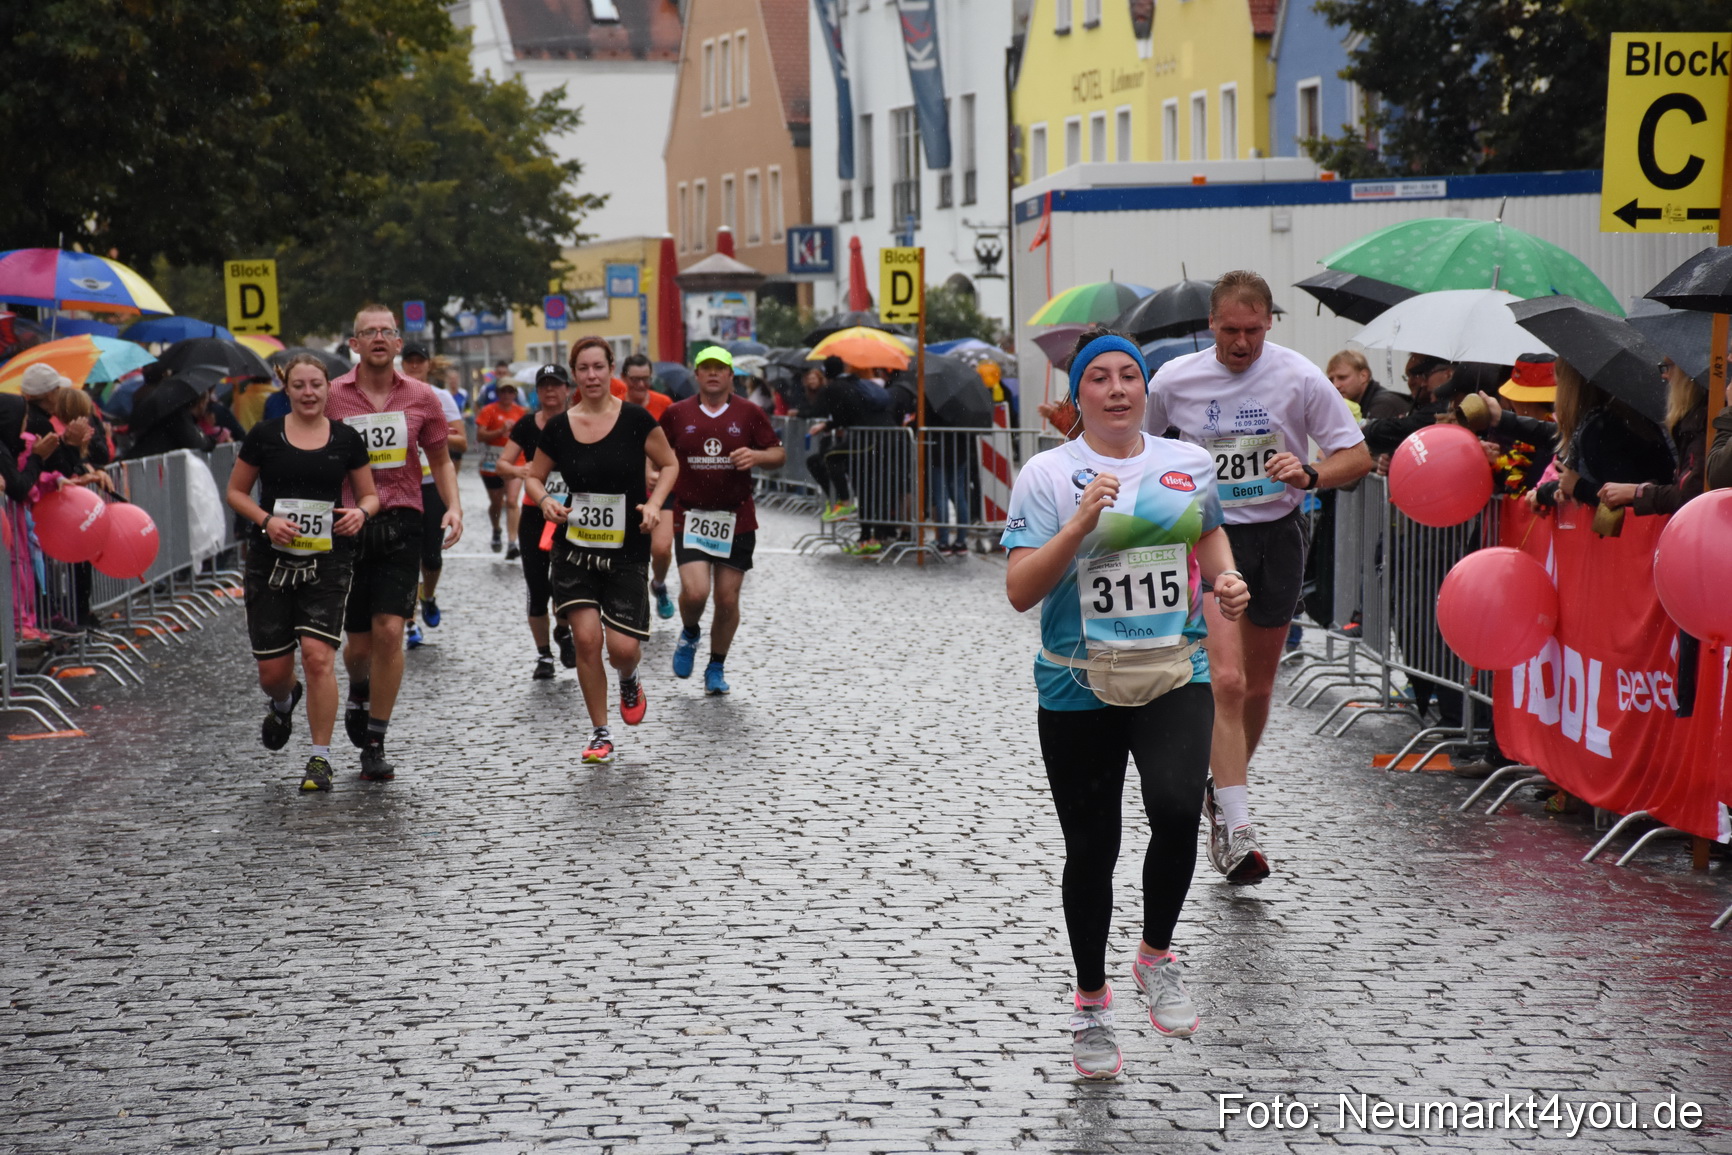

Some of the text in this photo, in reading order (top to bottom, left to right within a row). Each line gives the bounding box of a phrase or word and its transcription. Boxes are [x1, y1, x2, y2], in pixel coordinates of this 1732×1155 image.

[1626, 42, 1730, 76] Block
[1072, 69, 1102, 104] HOTEL
[1638, 92, 1708, 191] C
[884, 250, 919, 264] Block
[231, 264, 270, 277] Block
[892, 270, 912, 305] D
[240, 284, 265, 319] D
[1234, 419, 1270, 427] 16.09.2007
[1233, 486, 1264, 497] Georg
[579, 507, 614, 527] 336
[577, 531, 614, 540] Alexandra
[690, 517, 730, 540] 2636
[291, 539, 312, 548] Karin
[1127, 549, 1176, 564] BOCK
[1092, 570, 1180, 613] 3115
[1114, 621, 1154, 638] Anna
